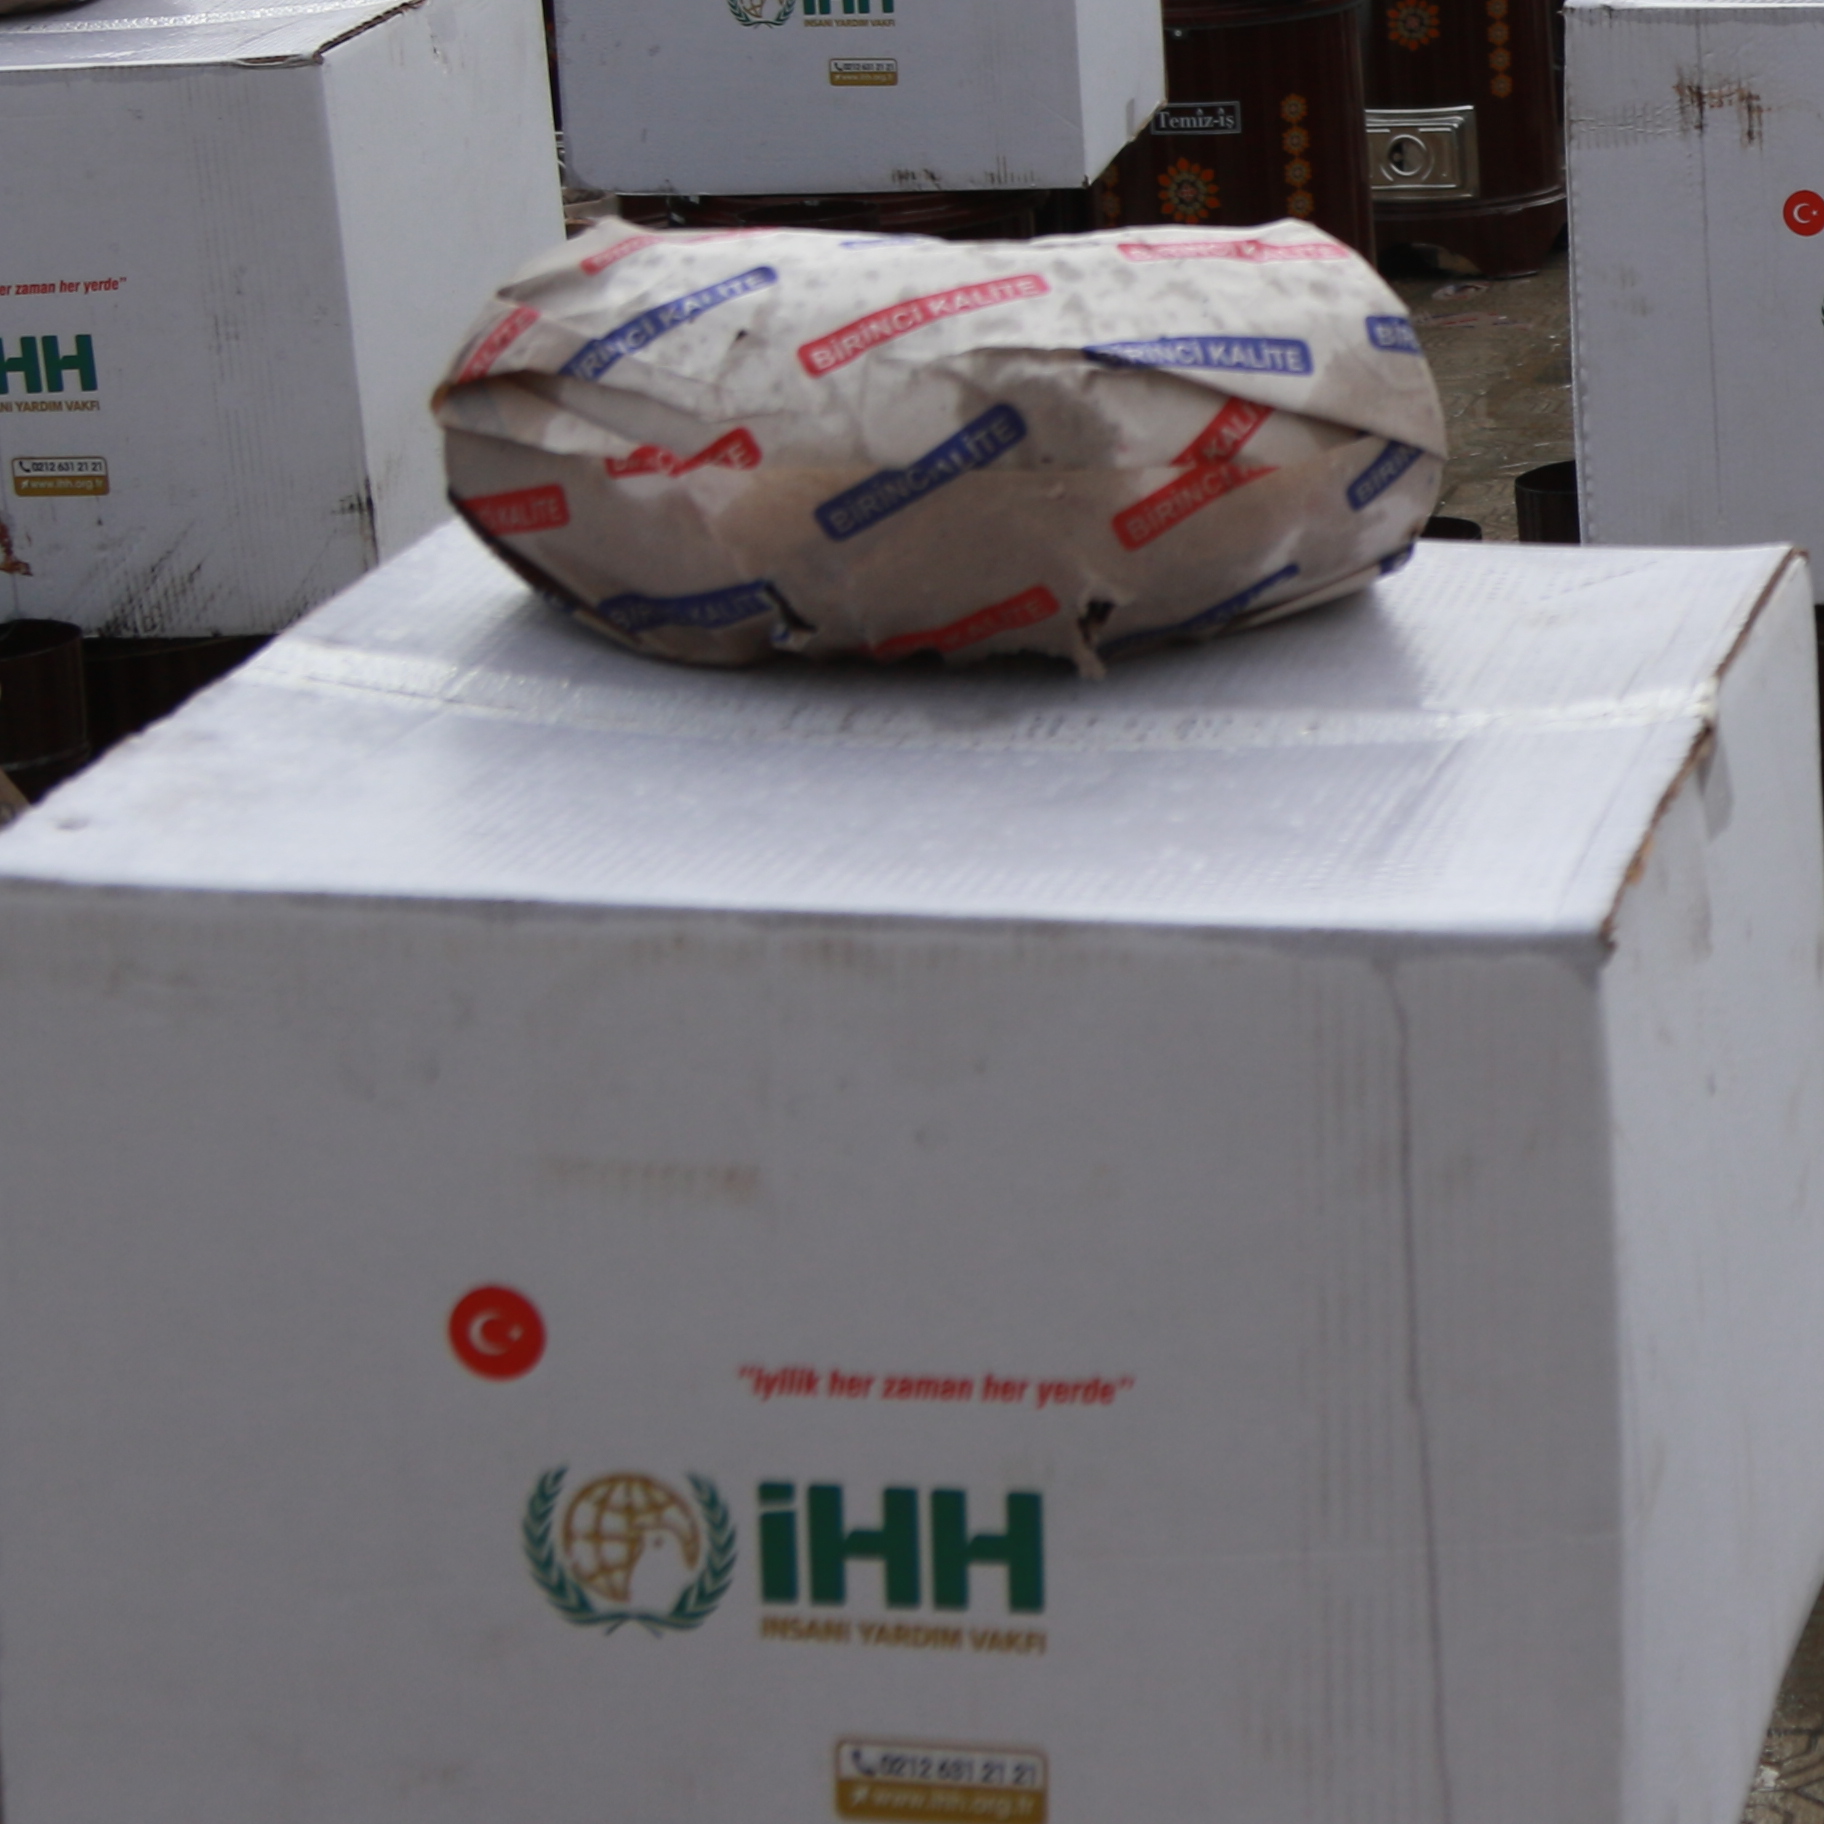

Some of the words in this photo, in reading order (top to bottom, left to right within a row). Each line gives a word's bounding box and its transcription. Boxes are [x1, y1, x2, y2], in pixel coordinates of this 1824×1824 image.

[0, 283, 11, 297] er
[15, 281, 55, 296] zaman
[59, 279, 81, 293] her
[1207, 343, 1305, 372] KALİTE
[15, 400, 63, 413] YARDIM
[66, 400, 100, 412] VAKFI
[32, 461, 56, 473] 0212
[58, 461, 75, 472] 631
[77, 461, 91, 472] 21
[92, 461, 103, 472] 21
[828, 1371, 872, 1398] her
[881, 1376, 972, 1401] zaman
[982, 1375, 1026, 1402] her
